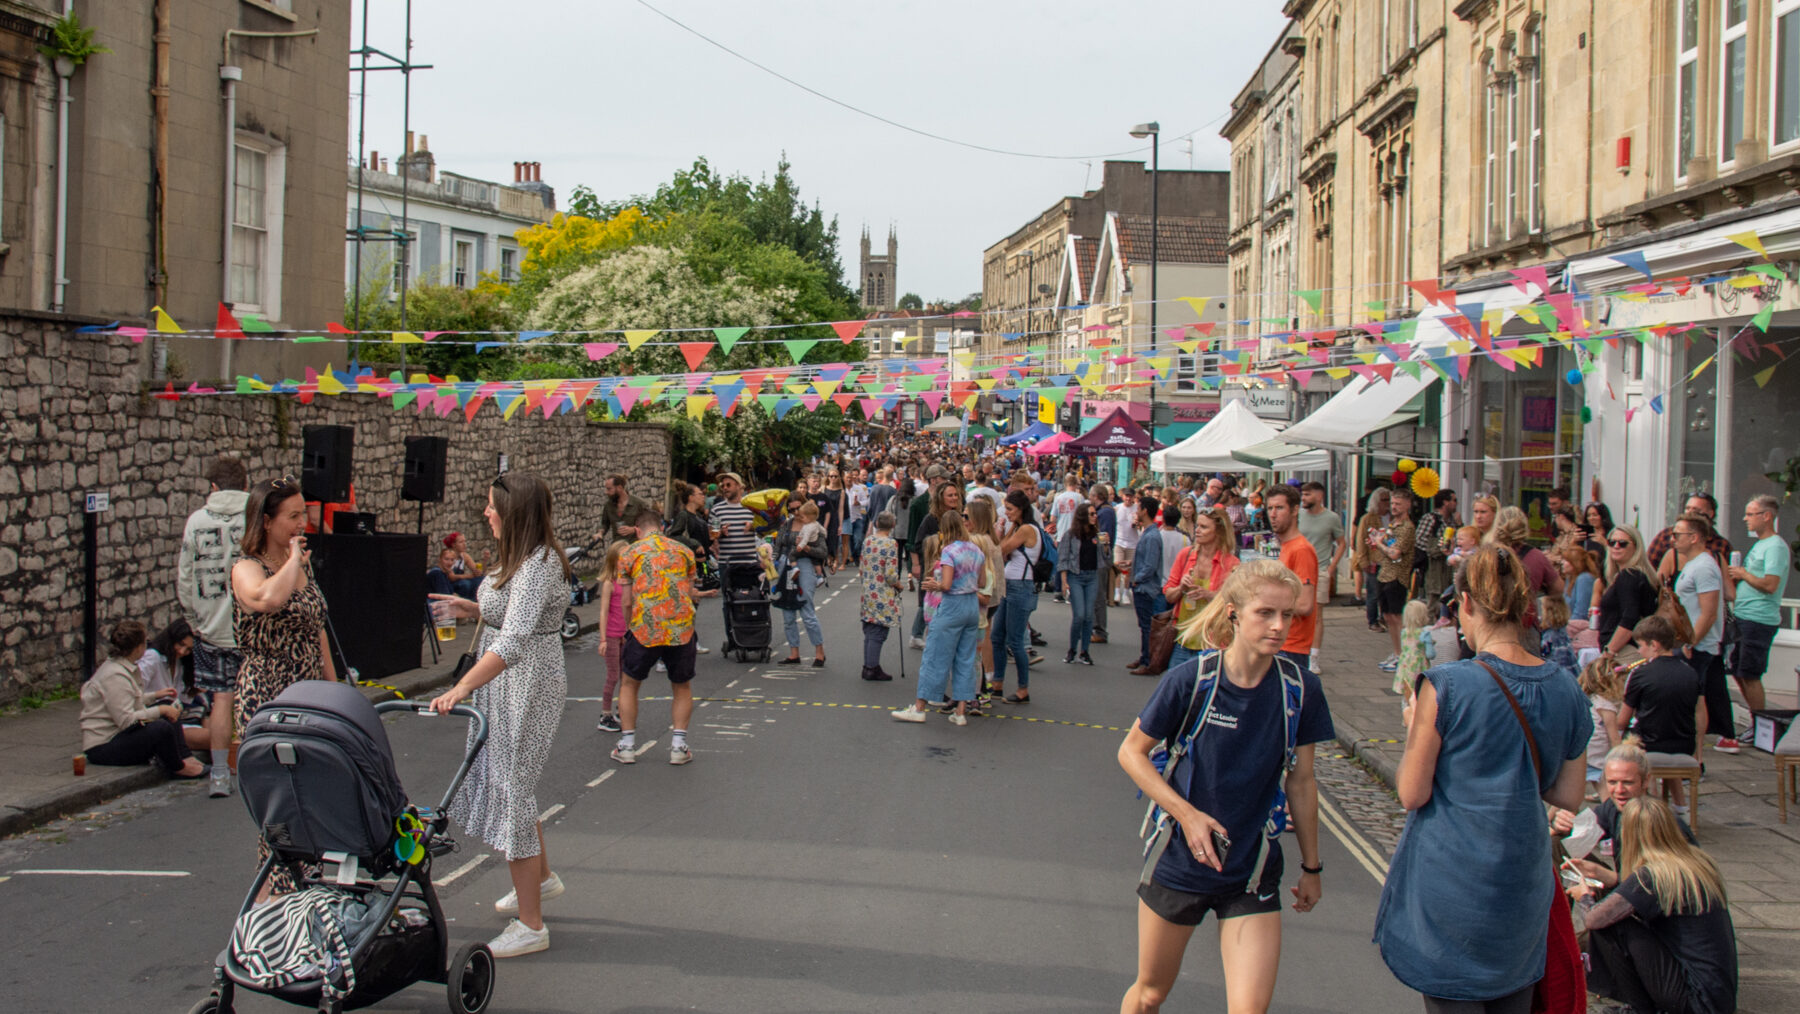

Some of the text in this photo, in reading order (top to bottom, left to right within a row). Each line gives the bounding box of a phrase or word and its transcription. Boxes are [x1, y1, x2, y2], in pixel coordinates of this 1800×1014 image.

[1260, 396, 1286, 406] Meze
[1082, 446, 1097, 454] How
[1099, 447, 1126, 456] learning
[1220, 713, 1238, 722] Leader
